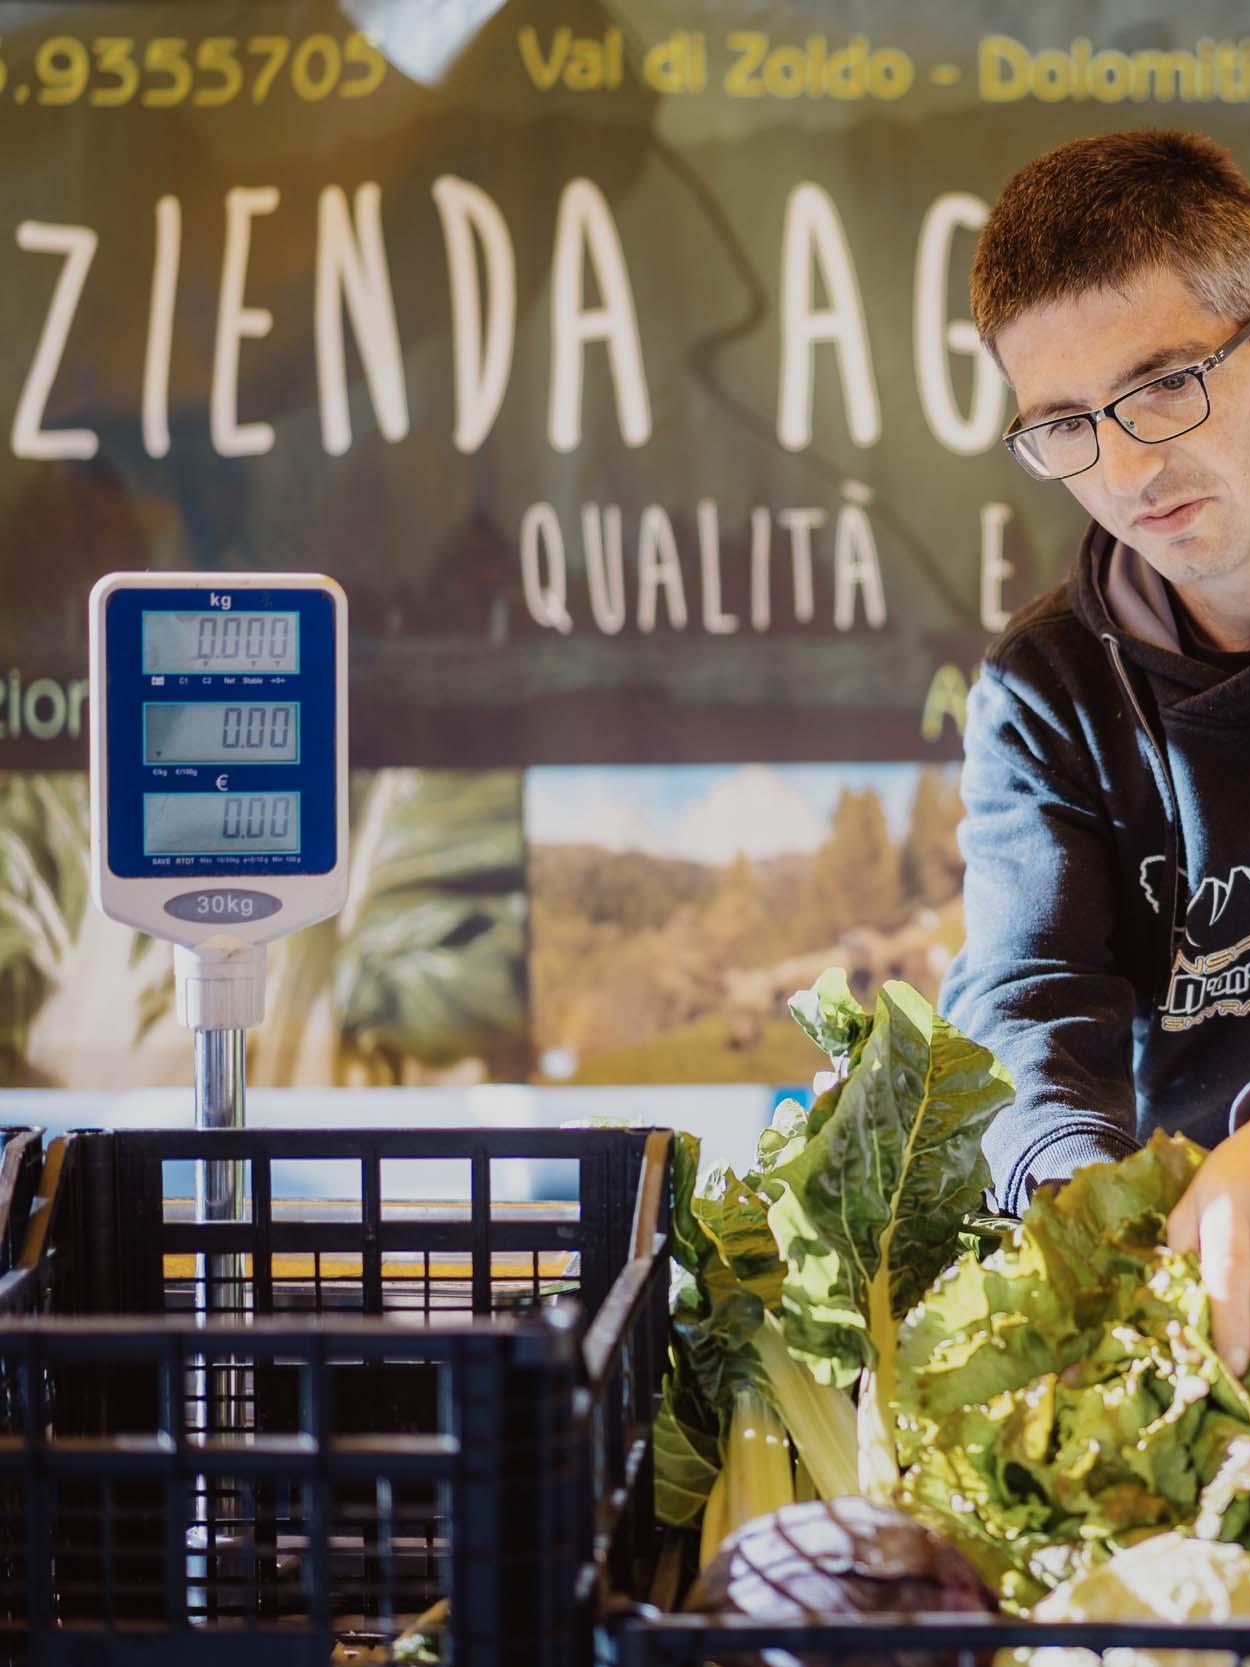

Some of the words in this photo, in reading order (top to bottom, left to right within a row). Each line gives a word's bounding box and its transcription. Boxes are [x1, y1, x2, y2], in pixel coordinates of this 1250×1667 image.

[0, 33, 387, 108] .9355705
[517, 24, 624, 92] Val
[641, 30, 707, 95] di
[723, 30, 915, 101] Zoldo
[11, 174, 652, 460] ZIENDA
[519, 478, 888, 636] QUALITÀ
[980, 501, 1014, 634] E
[210, 592, 232, 610] kg
[198, 616, 289, 660] 0.000
[222, 707, 290, 748] 0.00
[215, 774, 229, 792] €
[221, 798, 291, 839] 0.00
[197, 896, 254, 916] 30kg
